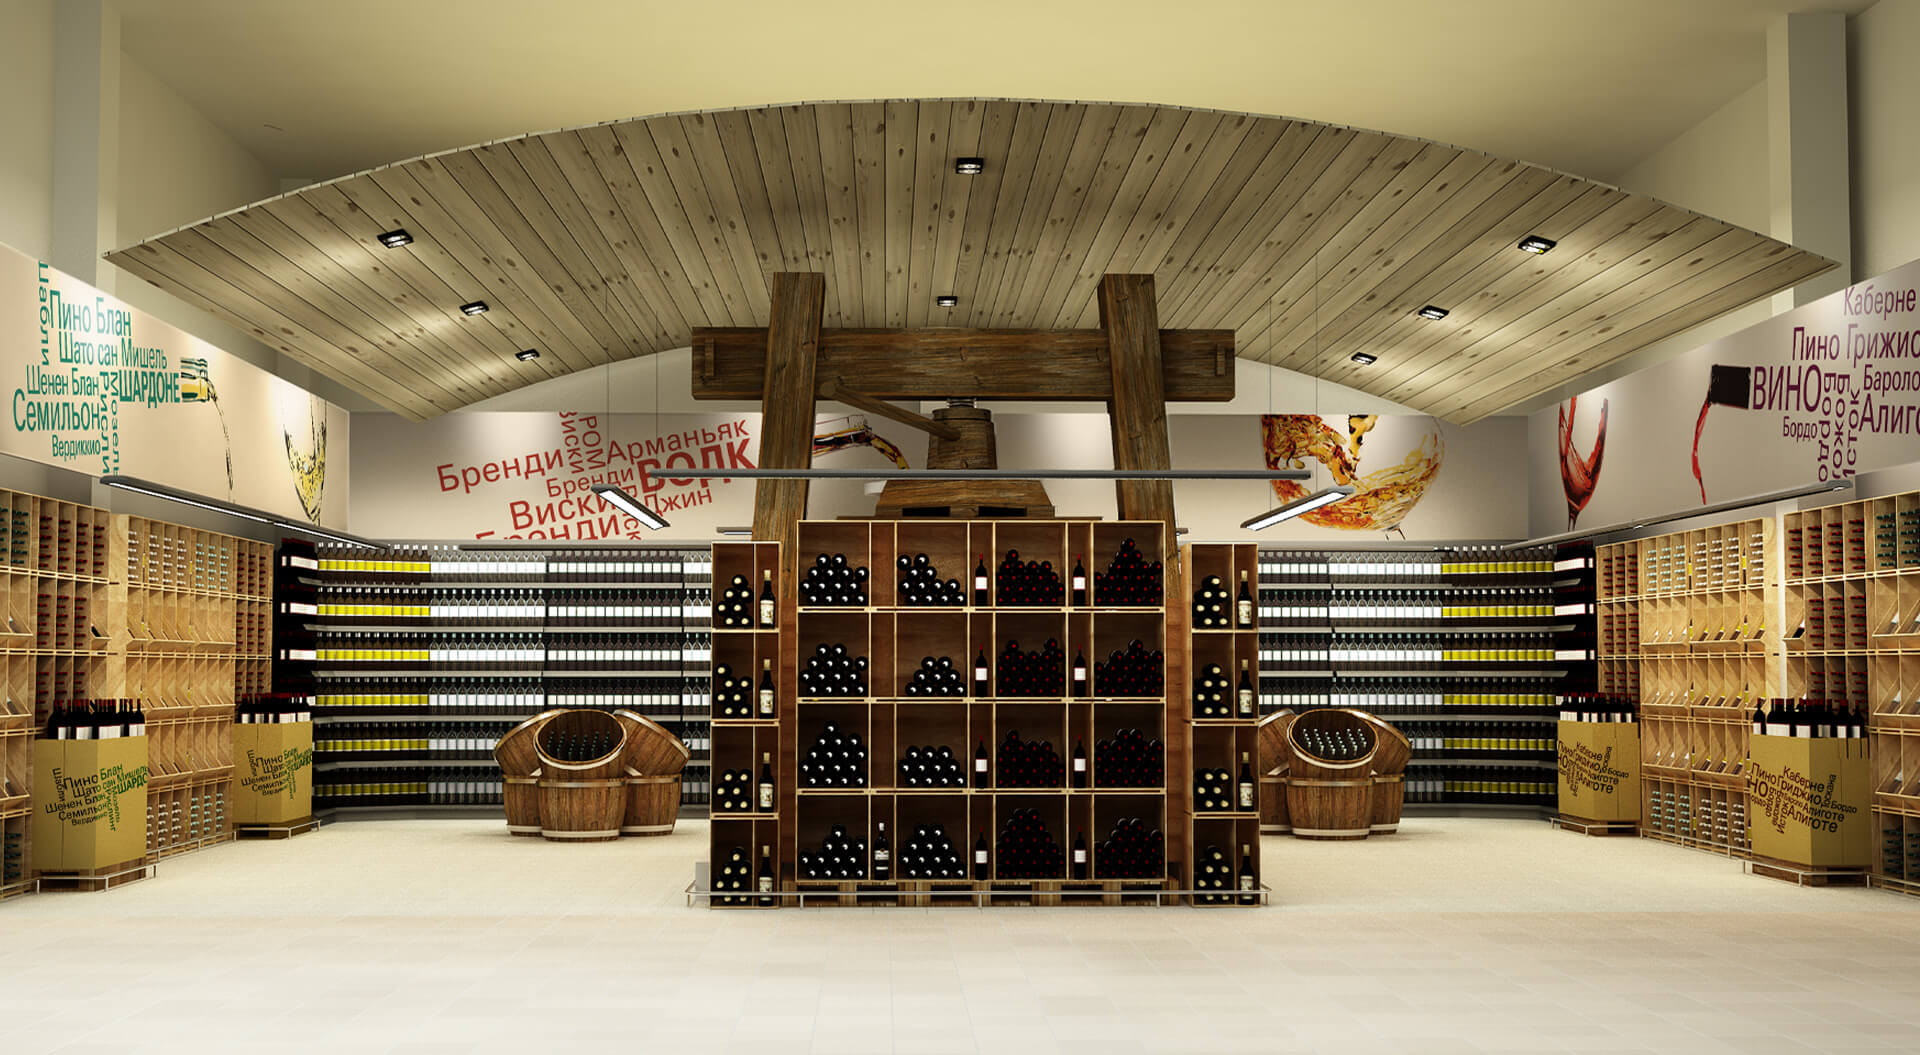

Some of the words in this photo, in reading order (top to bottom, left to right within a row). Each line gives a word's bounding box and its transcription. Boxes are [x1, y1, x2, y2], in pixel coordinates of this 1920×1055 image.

[50, 289, 91, 333] Пино
[96, 296, 132, 337] Блан
[1844, 284, 1917, 320] Каберне
[59, 331, 94, 366] Шато
[98, 341, 118, 367] сан
[121, 337, 167, 370] Мишель
[1791, 326, 1840, 361] Пино
[26, 364, 69, 396] Шенен
[72, 367, 100, 397] Блан
[118, 369, 181, 409] ШАРДОНЕ
[1752, 364, 1821, 412] ВИНО
[13, 388, 101, 432] Семильон
[1817, 373, 1837, 482] Бордо
[578, 416, 606, 470] РОМ
[607, 419, 751, 465] Арманьяк
[1783, 416, 1818, 442] Бордо
[51, 434, 101, 461] Вердиккио
[437, 448, 564, 494] Бренди
[546, 467, 635, 499] Бренди
[509, 492, 616, 531] Виски
[644, 489, 713, 518] Джин
[63, 774, 99, 790] Пино
[100, 763, 123, 780] Блан
[73, 784, 101, 798] Шато
[1751, 762, 1777, 785] Пино
[1783, 765, 1825, 793] Каберне
[45, 799, 83, 814] Шенен
[1787, 804, 1839, 833] Алиготе
